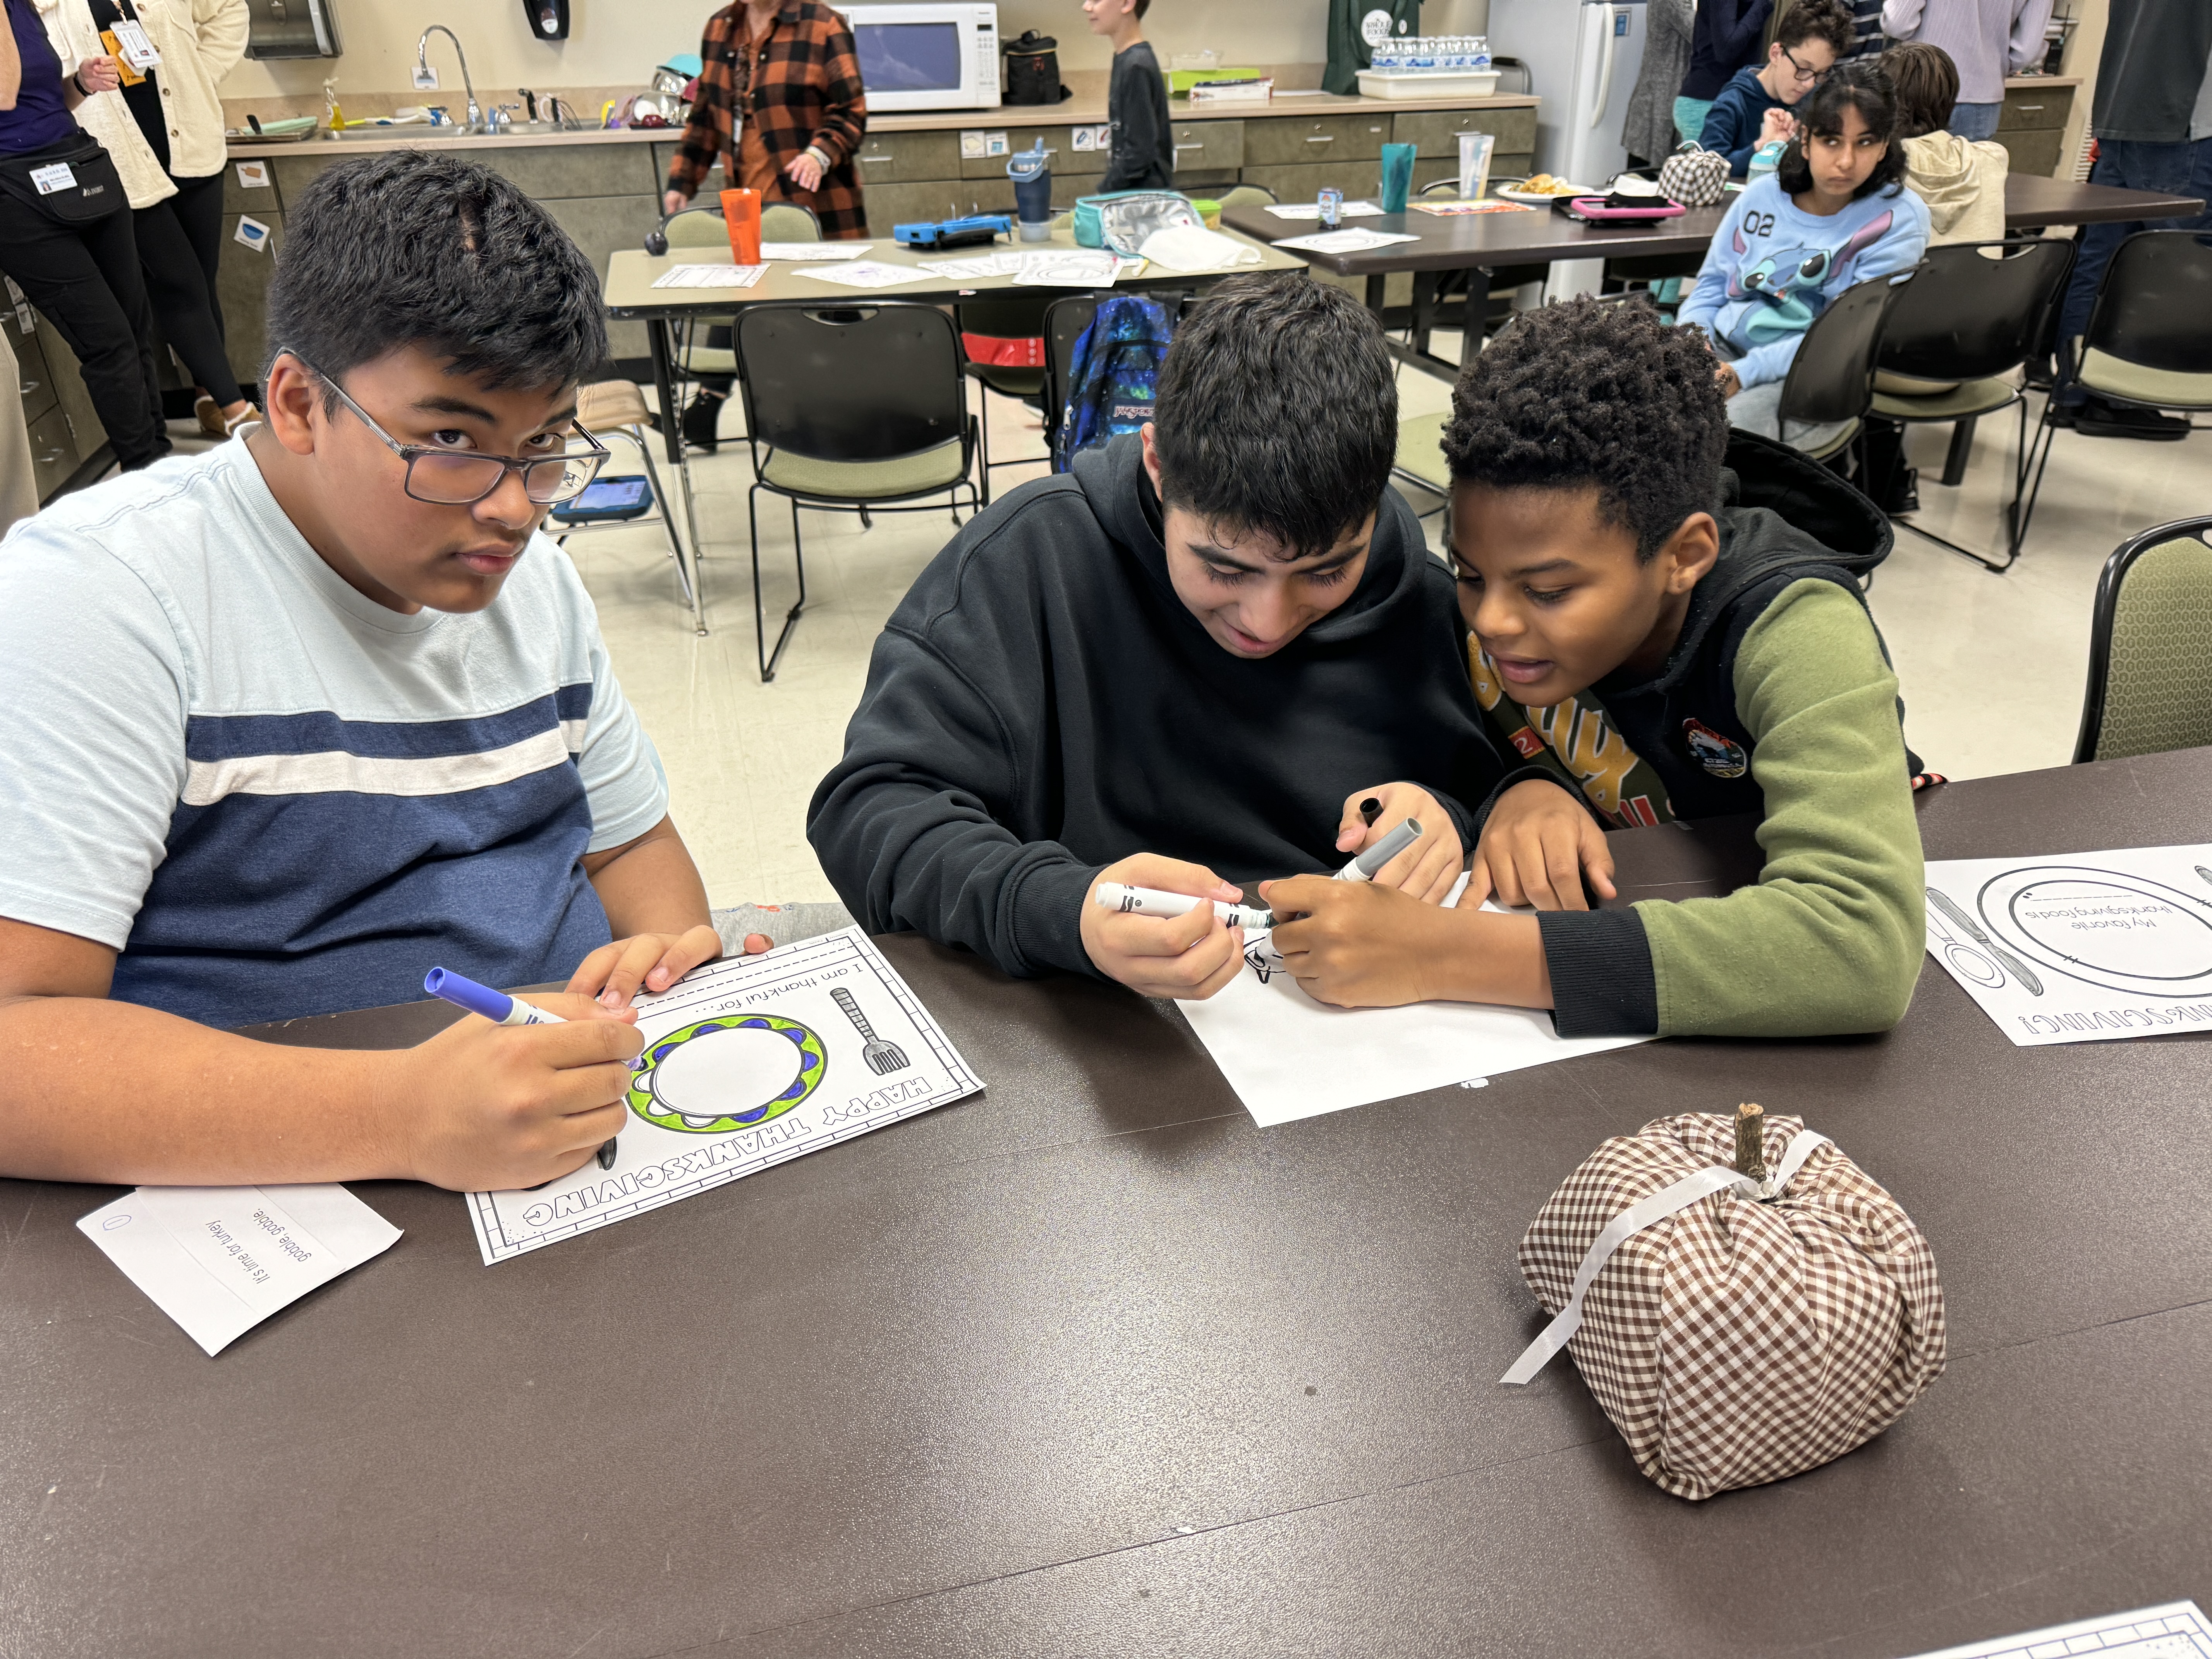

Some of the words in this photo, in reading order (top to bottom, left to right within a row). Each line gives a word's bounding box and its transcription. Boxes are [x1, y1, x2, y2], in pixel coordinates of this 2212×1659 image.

[1743, 210, 1775, 237] 02
[2040, 910, 2077, 919] food
[2075, 905, 2173, 916] thanksgiving
[2071, 920, 2131, 930] favorite
[2132, 917, 2157, 927] My
[821, 969, 848, 980] am
[853, 963, 863, 973] I
[747, 977, 817, 1005] thankful
[2018, 1005, 2212, 1034] NKSGIVING!
[823, 1077, 933, 1125] HAPPY
[523, 1118, 811, 1227] THANKSGIVING
[253, 1208, 285, 1235] gobble.
[205, 1220, 233, 1245] turkey
[226, 1243, 243, 1256] for
[279, 1233, 311, 1262] gobble,
[238, 1254, 259, 1272] time
[252, 1269, 270, 1284] It's
